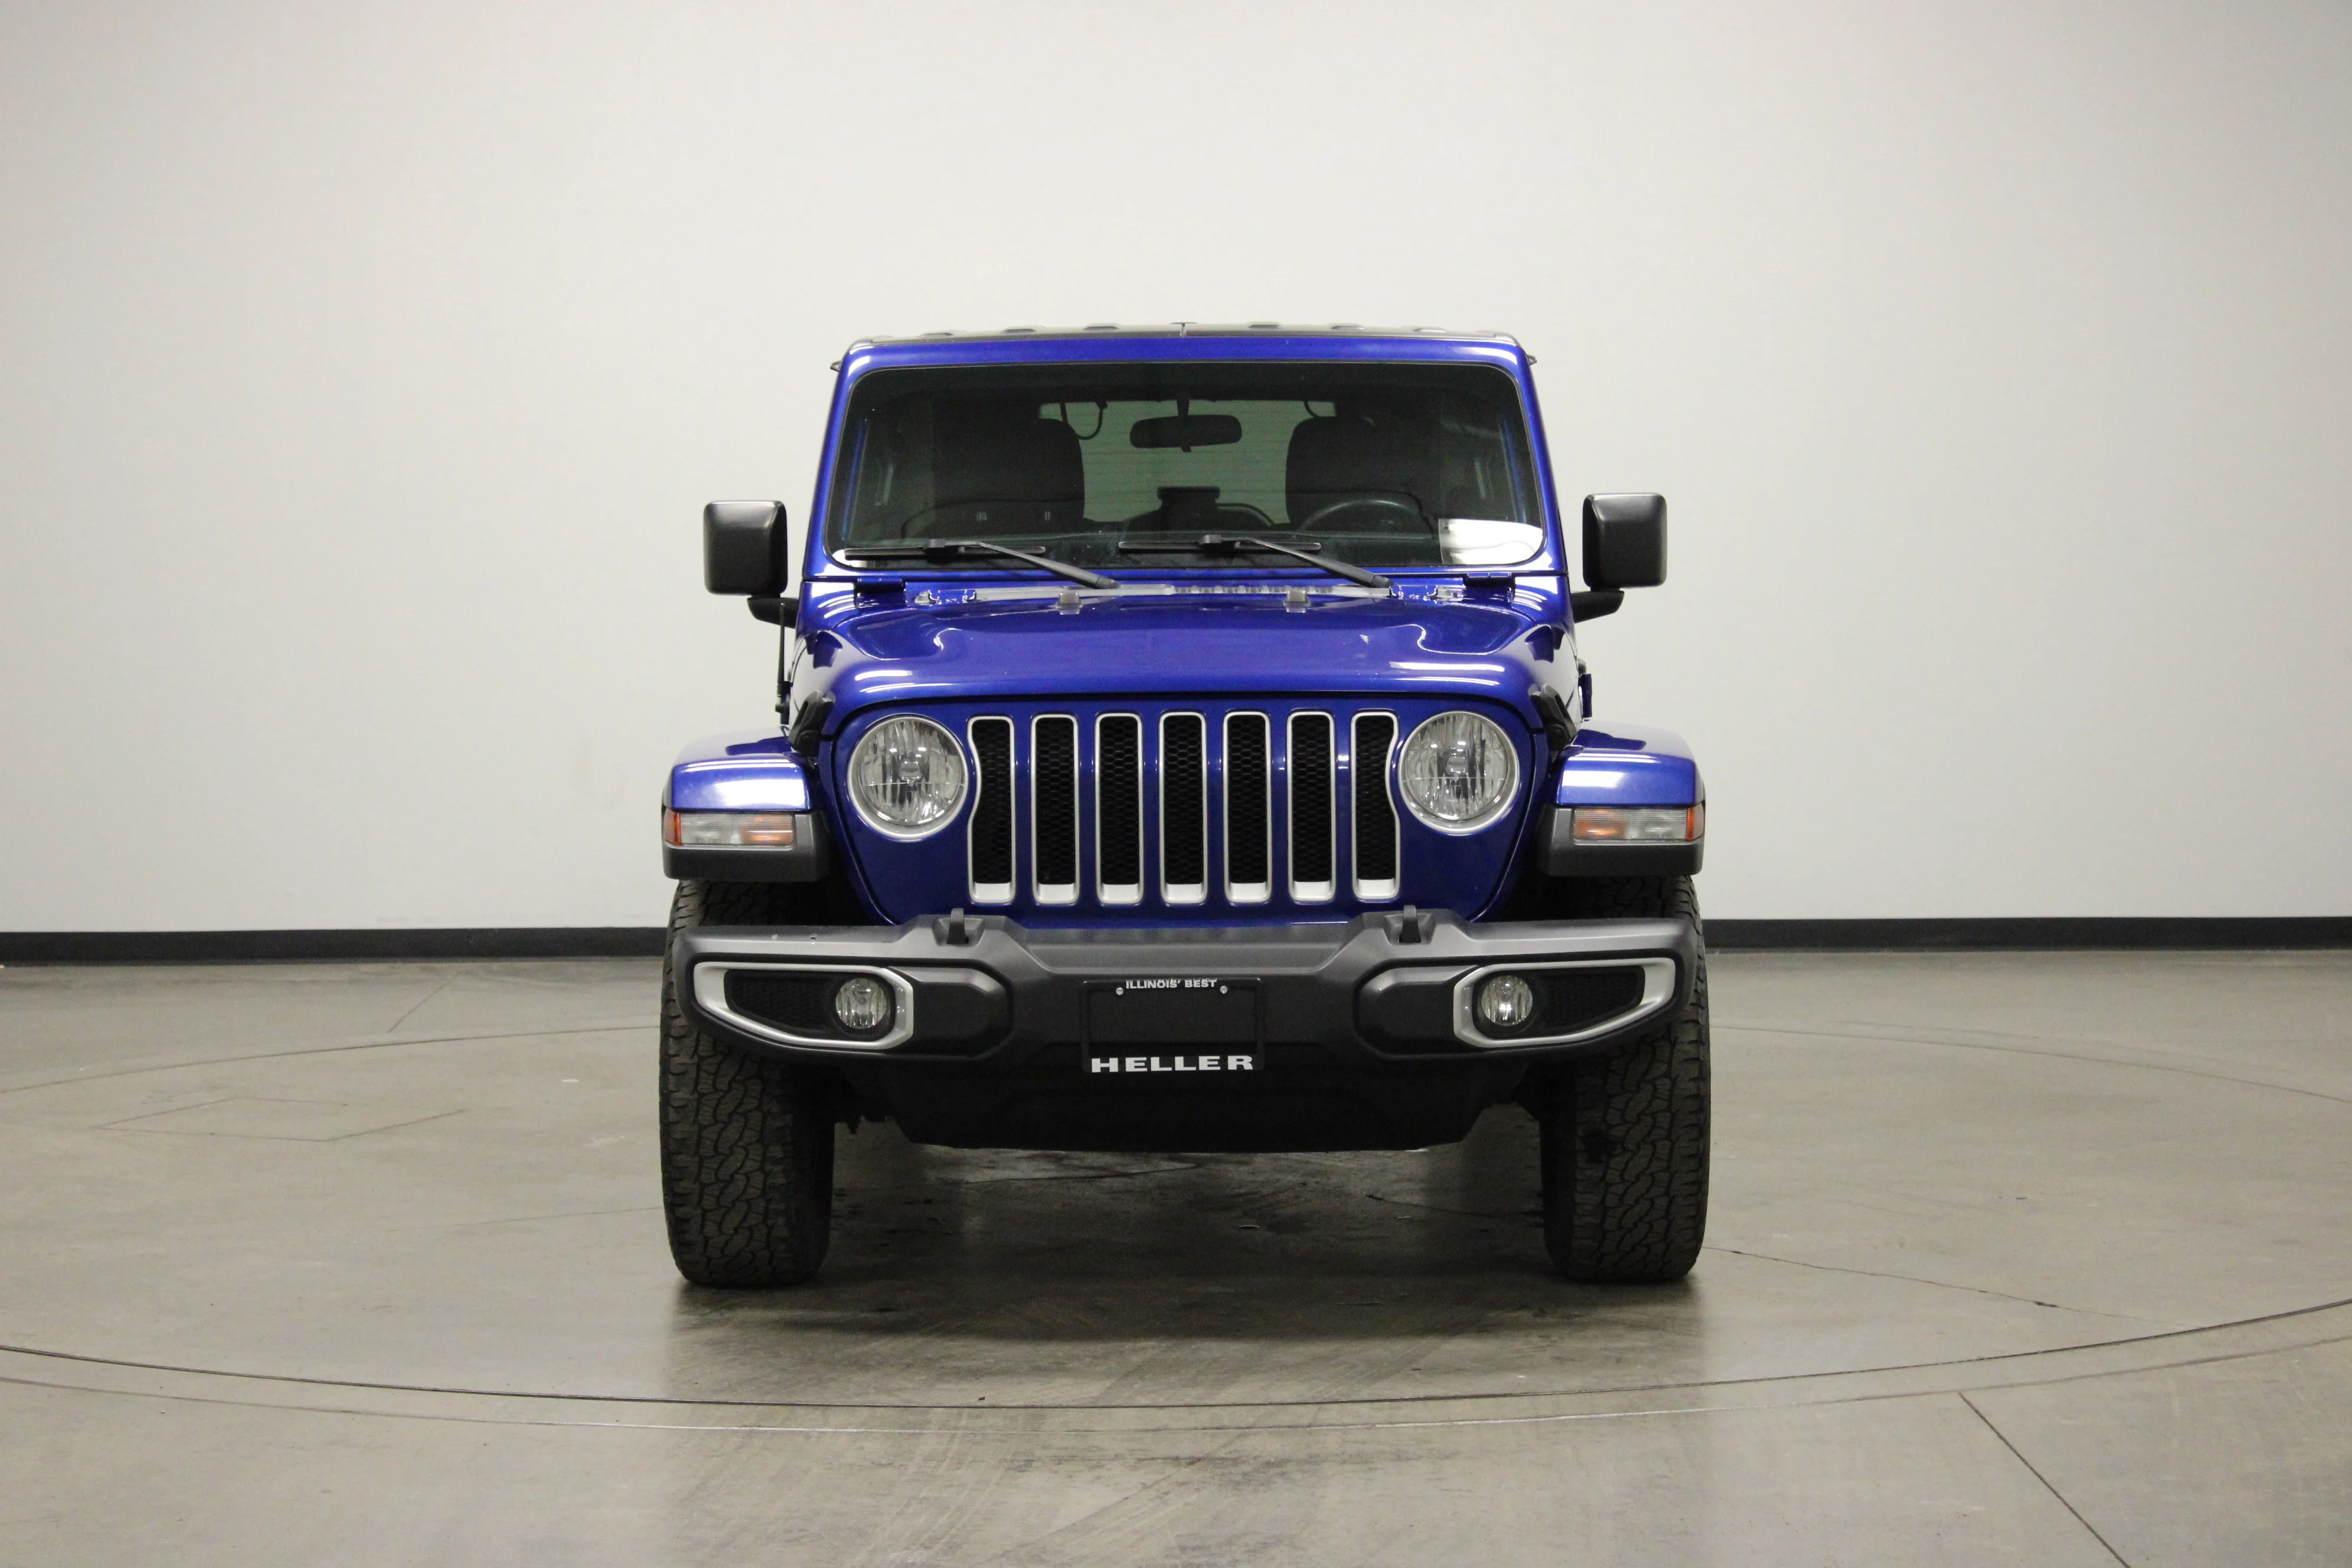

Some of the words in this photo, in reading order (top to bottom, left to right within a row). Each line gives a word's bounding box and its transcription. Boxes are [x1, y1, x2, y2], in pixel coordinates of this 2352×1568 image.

[1126, 979, 1181, 989] ILLINOIS'
[1184, 978, 1217, 988] BEST
[1092, 1055, 1253, 1073] HELLER
